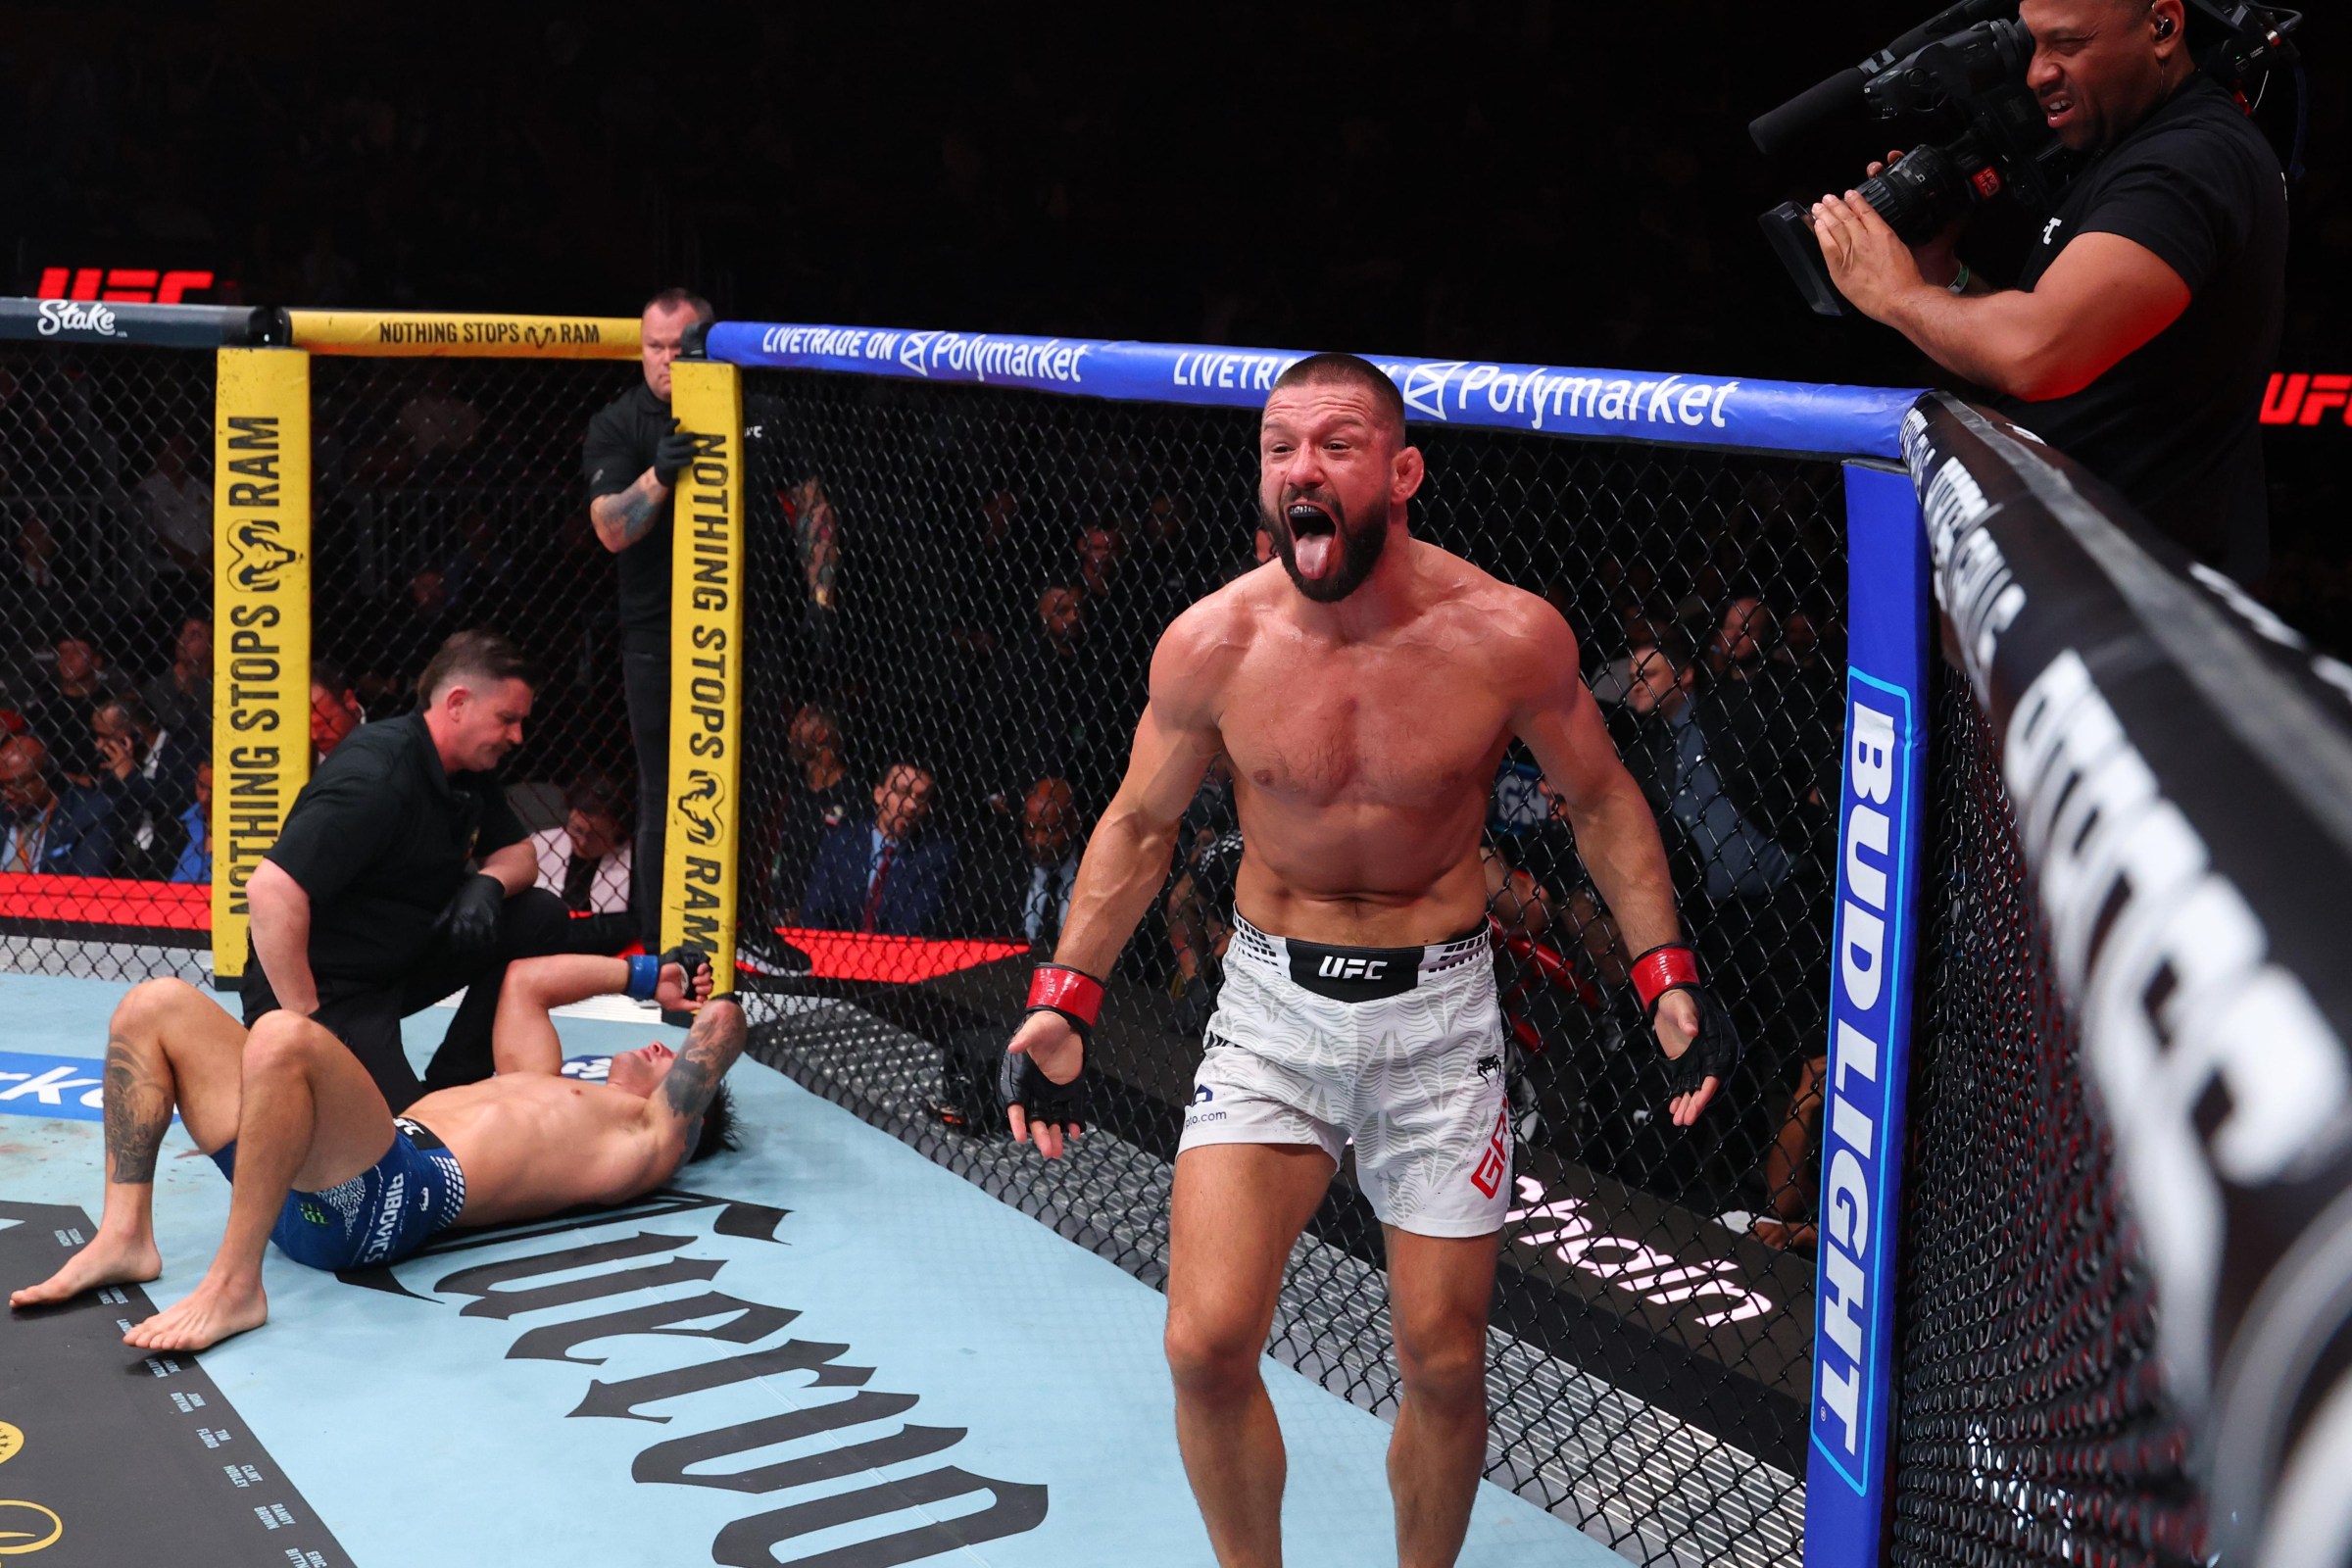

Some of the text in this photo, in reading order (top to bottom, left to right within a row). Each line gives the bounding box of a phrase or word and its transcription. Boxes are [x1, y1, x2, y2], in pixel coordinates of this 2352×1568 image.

[37, 268, 215, 305] UFC
[37, 299, 116, 336] Stake
[379, 323, 600, 344] NOTHING STOPS RAM
[763, 326, 1084, 382] LIVETRADE ON Polymarket
[1458, 362, 1740, 429] Polymarket
[2260, 373, 2352, 425] UF
[227, 417, 279, 507] RAM
[230, 606, 280, 732] STOPS
[683, 431, 728, 954] NOTHING STOPS RAM
[1318, 956, 1388, 980] UFC
[1822, 702, 1895, 1456] BUD LIGHT
[1184, 1109, 1227, 1130] pto.com
[1504, 1176, 1772, 1327] hain
[196, 1428, 220, 1449] FLORIO
[215, 1429, 232, 1442] TIM
[222, 1465, 250, 1489] HOBLEY
[240, 1464, 264, 1483] CLINT
[254, 1505, 280, 1530] BROWN
[270, 1503, 296, 1525] RANDY
